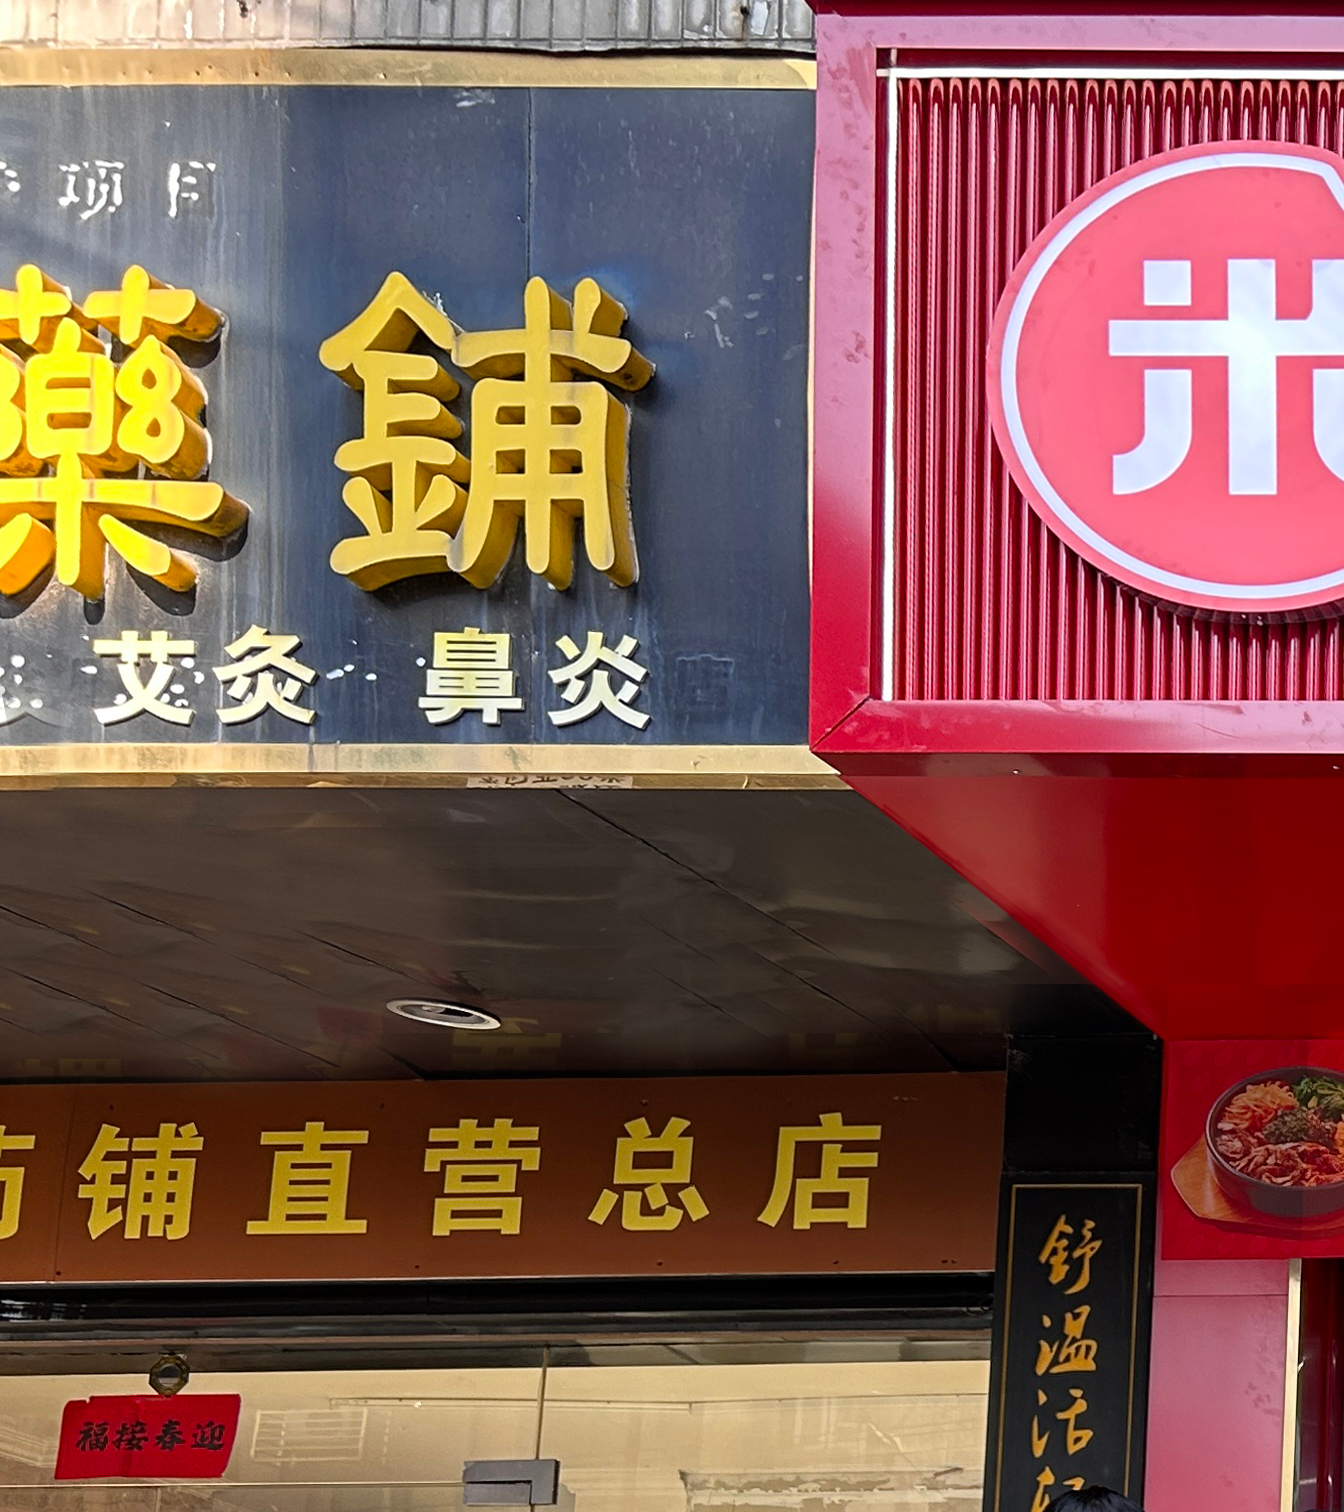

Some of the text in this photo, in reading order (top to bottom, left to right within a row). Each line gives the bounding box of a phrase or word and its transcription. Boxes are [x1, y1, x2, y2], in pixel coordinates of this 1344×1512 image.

[0, 1112, 883, 1241] 铺直营总店
